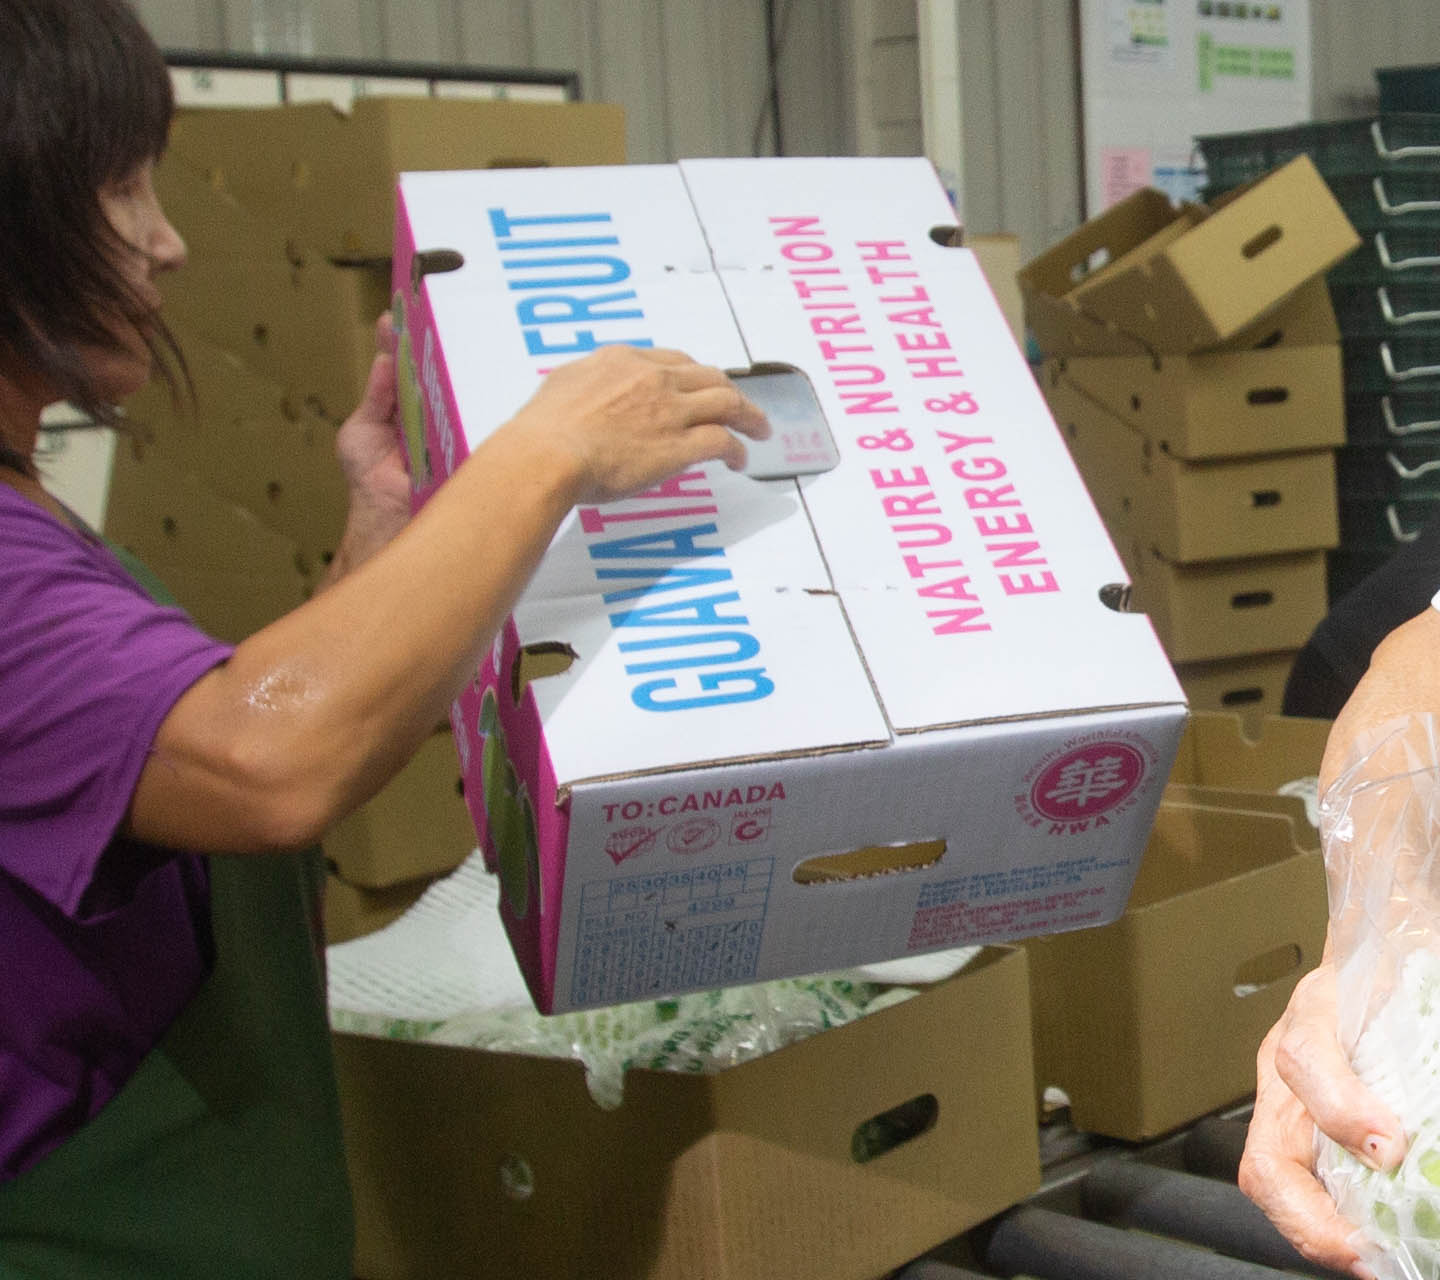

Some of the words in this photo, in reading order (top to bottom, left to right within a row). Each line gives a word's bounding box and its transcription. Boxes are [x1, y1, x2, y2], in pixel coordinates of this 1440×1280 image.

[487, 208, 654, 357] FRUIT
[768, 215, 900, 415] NUTRITION
[855, 240, 964, 379] HEALTH
[856, 427, 914, 452] &
[923, 390, 979, 415] &
[869, 465, 992, 636] NATURE
[936, 429, 1061, 596] ENERGY
[588, 522, 776, 713] GUAVA
[602, 781, 786, 822] TO:CANADA
